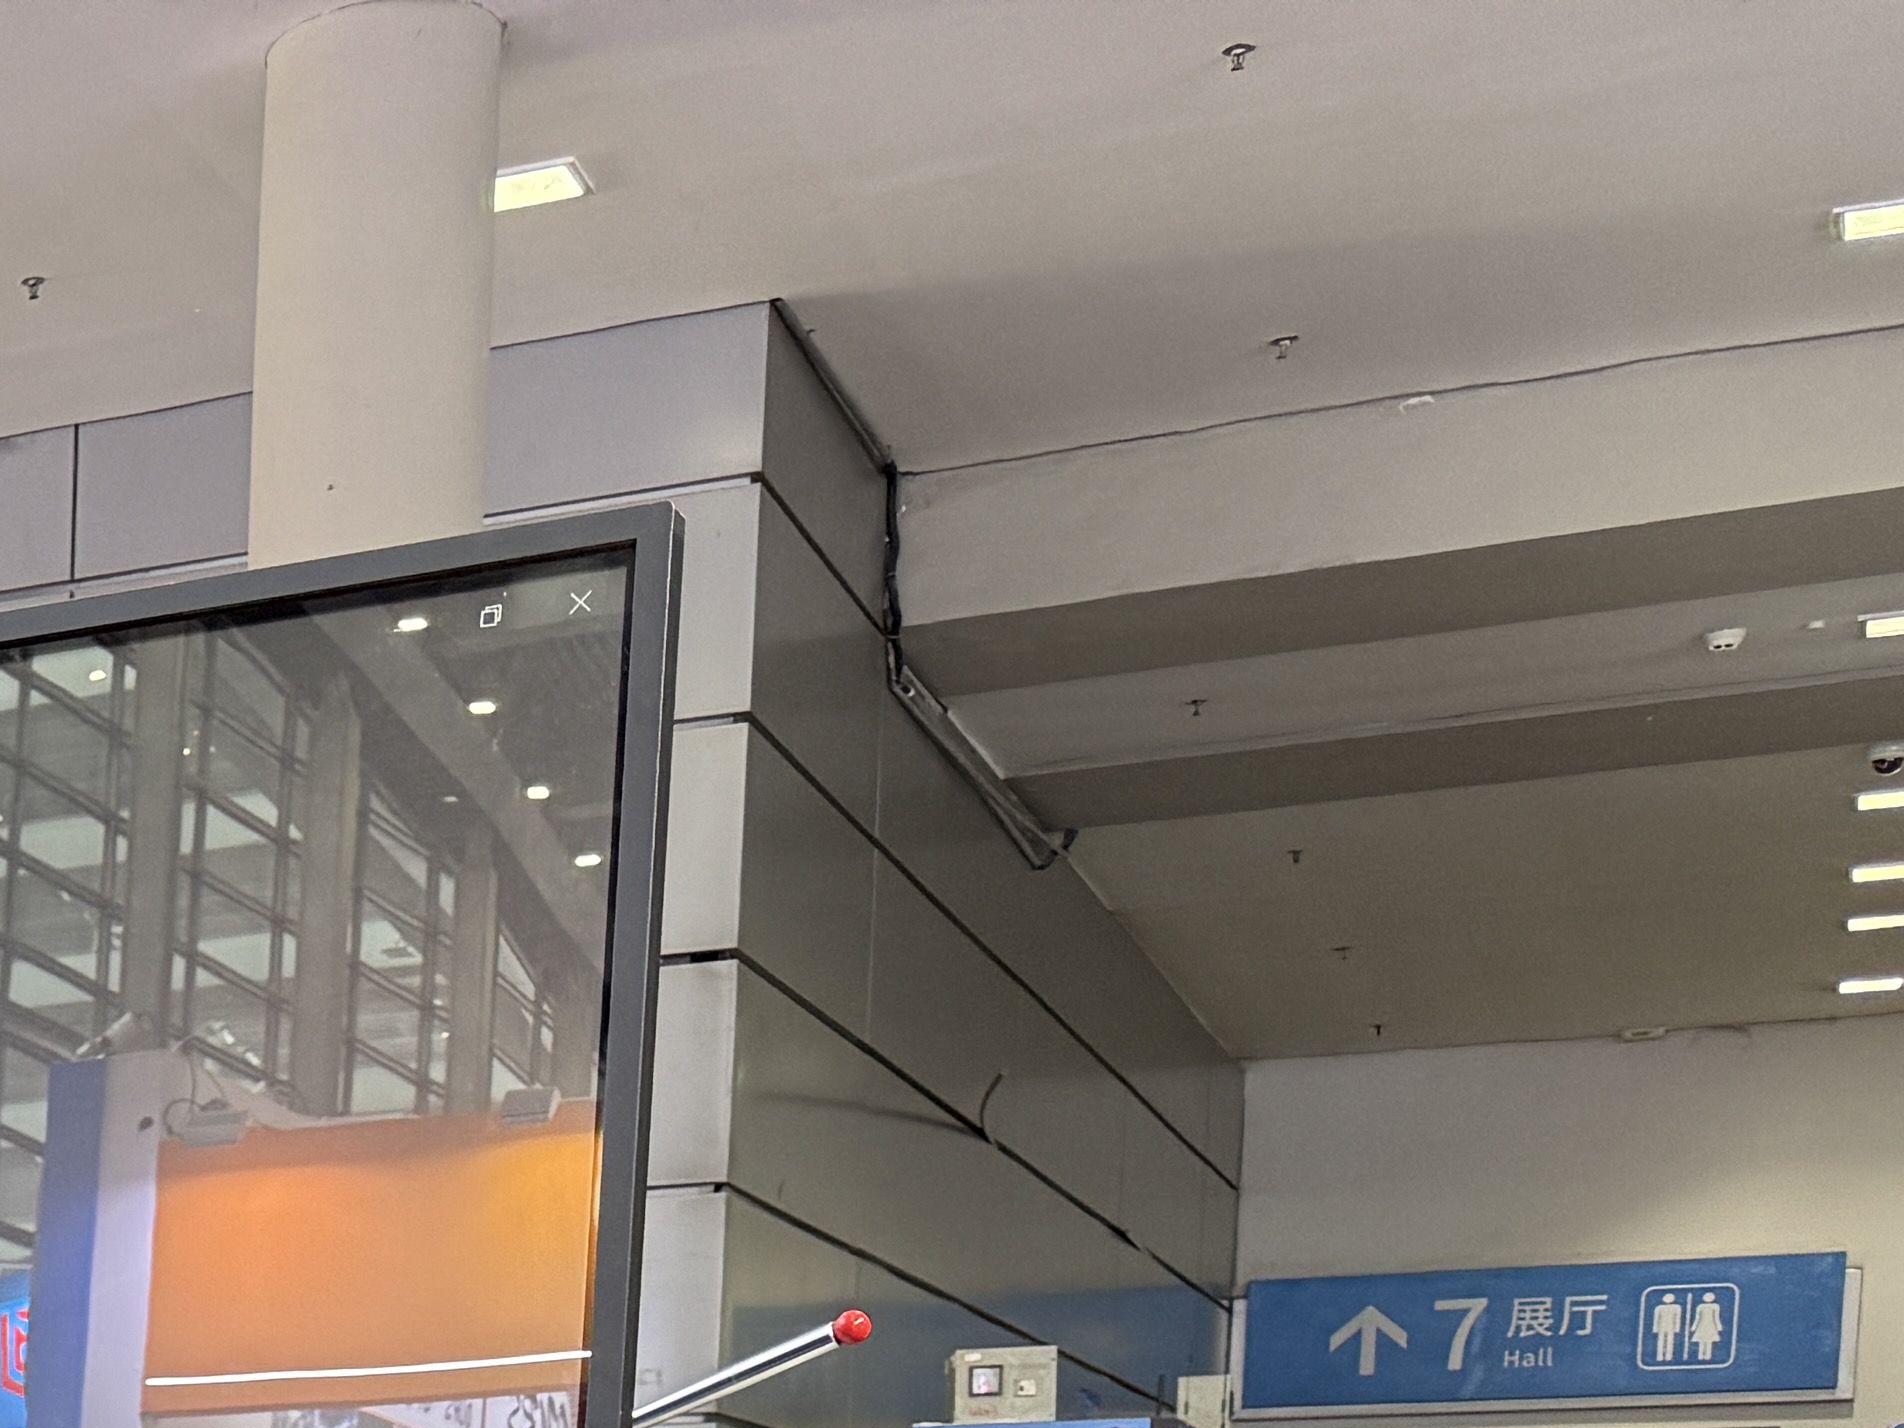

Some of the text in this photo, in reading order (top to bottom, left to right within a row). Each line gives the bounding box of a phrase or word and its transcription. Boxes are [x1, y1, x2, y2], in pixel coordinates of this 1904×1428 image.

[1434, 1294, 1608, 1371] 7 展厅
[1503, 1347, 1554, 1368] Hall
